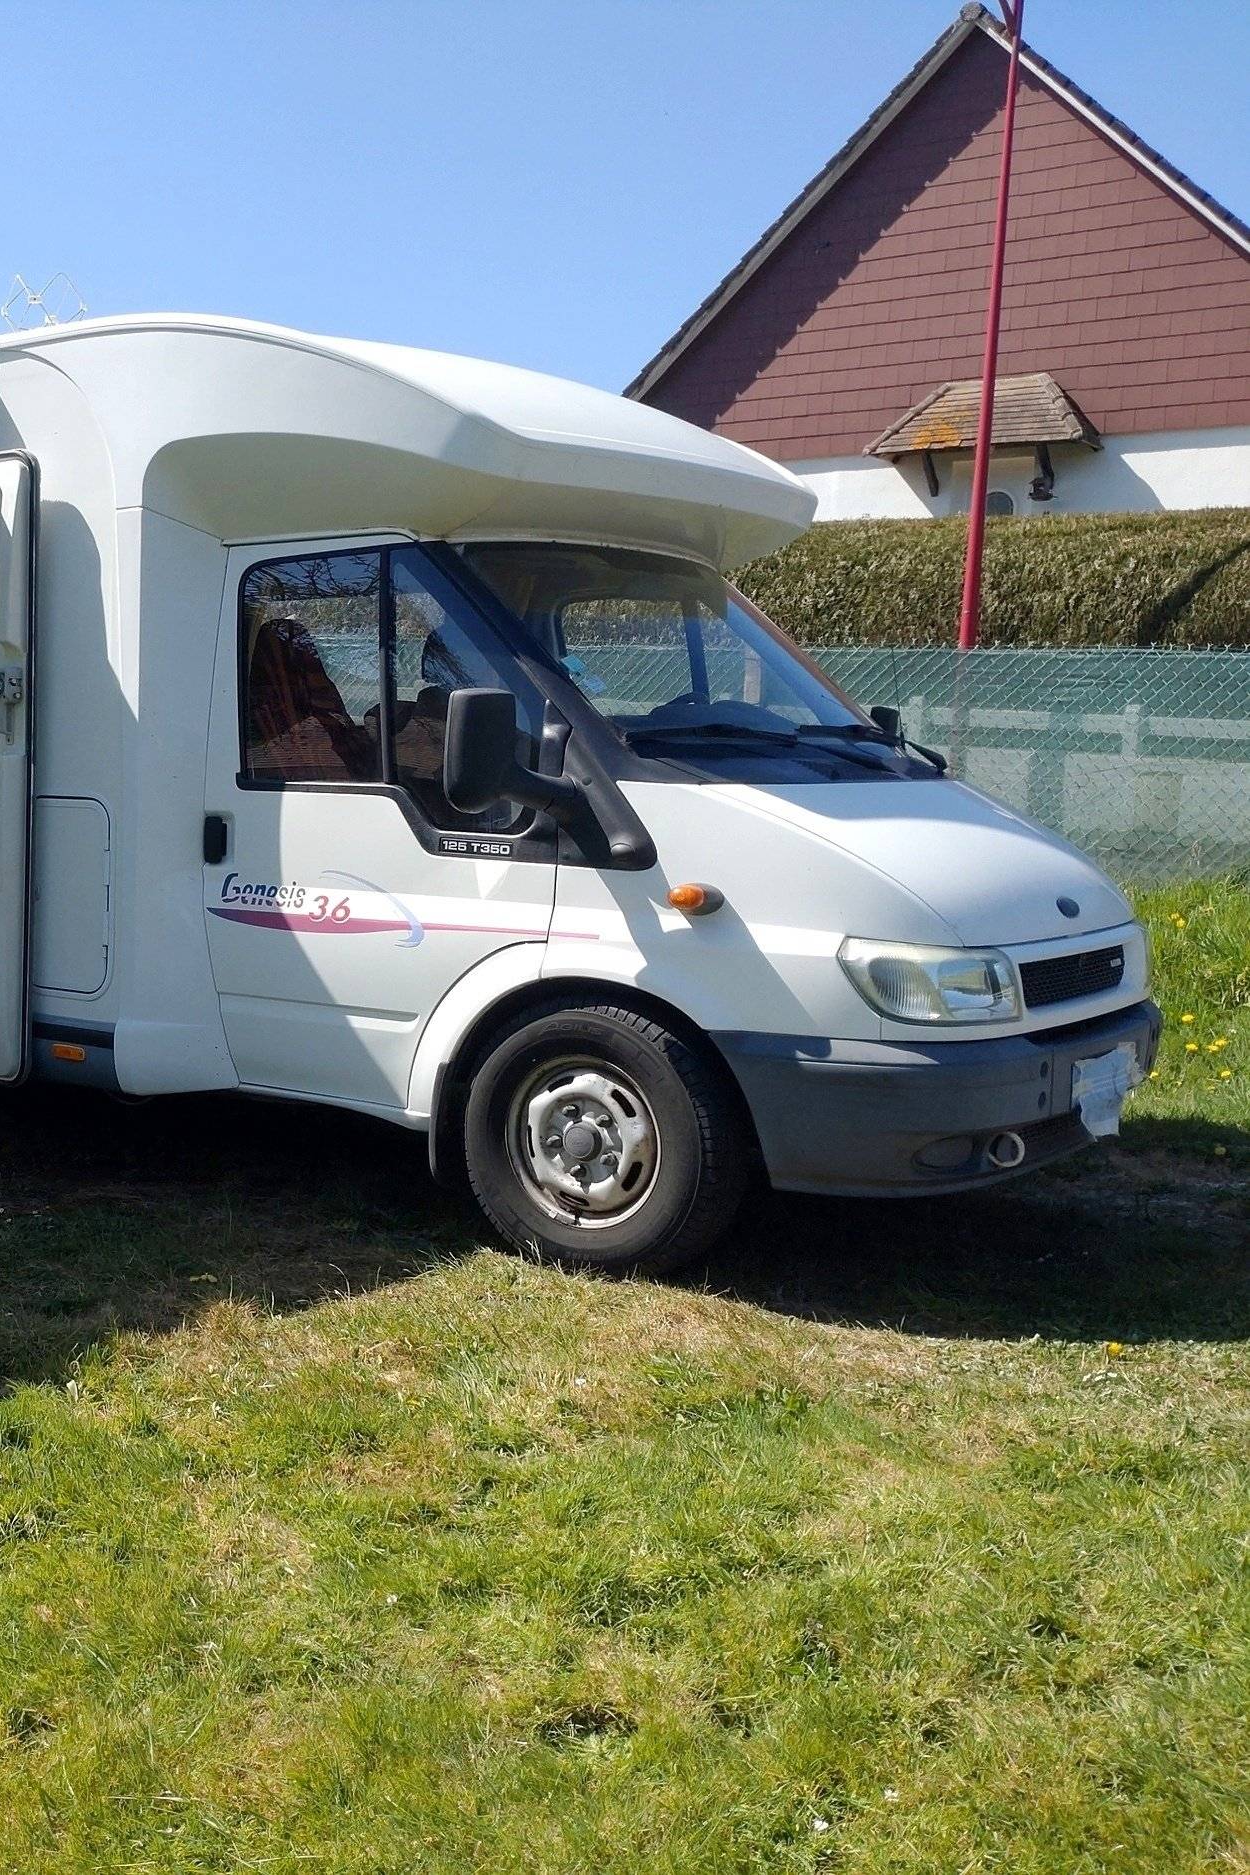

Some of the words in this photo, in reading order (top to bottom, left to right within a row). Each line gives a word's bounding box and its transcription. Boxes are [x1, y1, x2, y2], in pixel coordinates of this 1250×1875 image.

[442, 840, 468, 852] 125
[470, 842, 511, 855] T350
[221, 872, 306, 908] Genesis
[308, 895, 351, 922] 36
